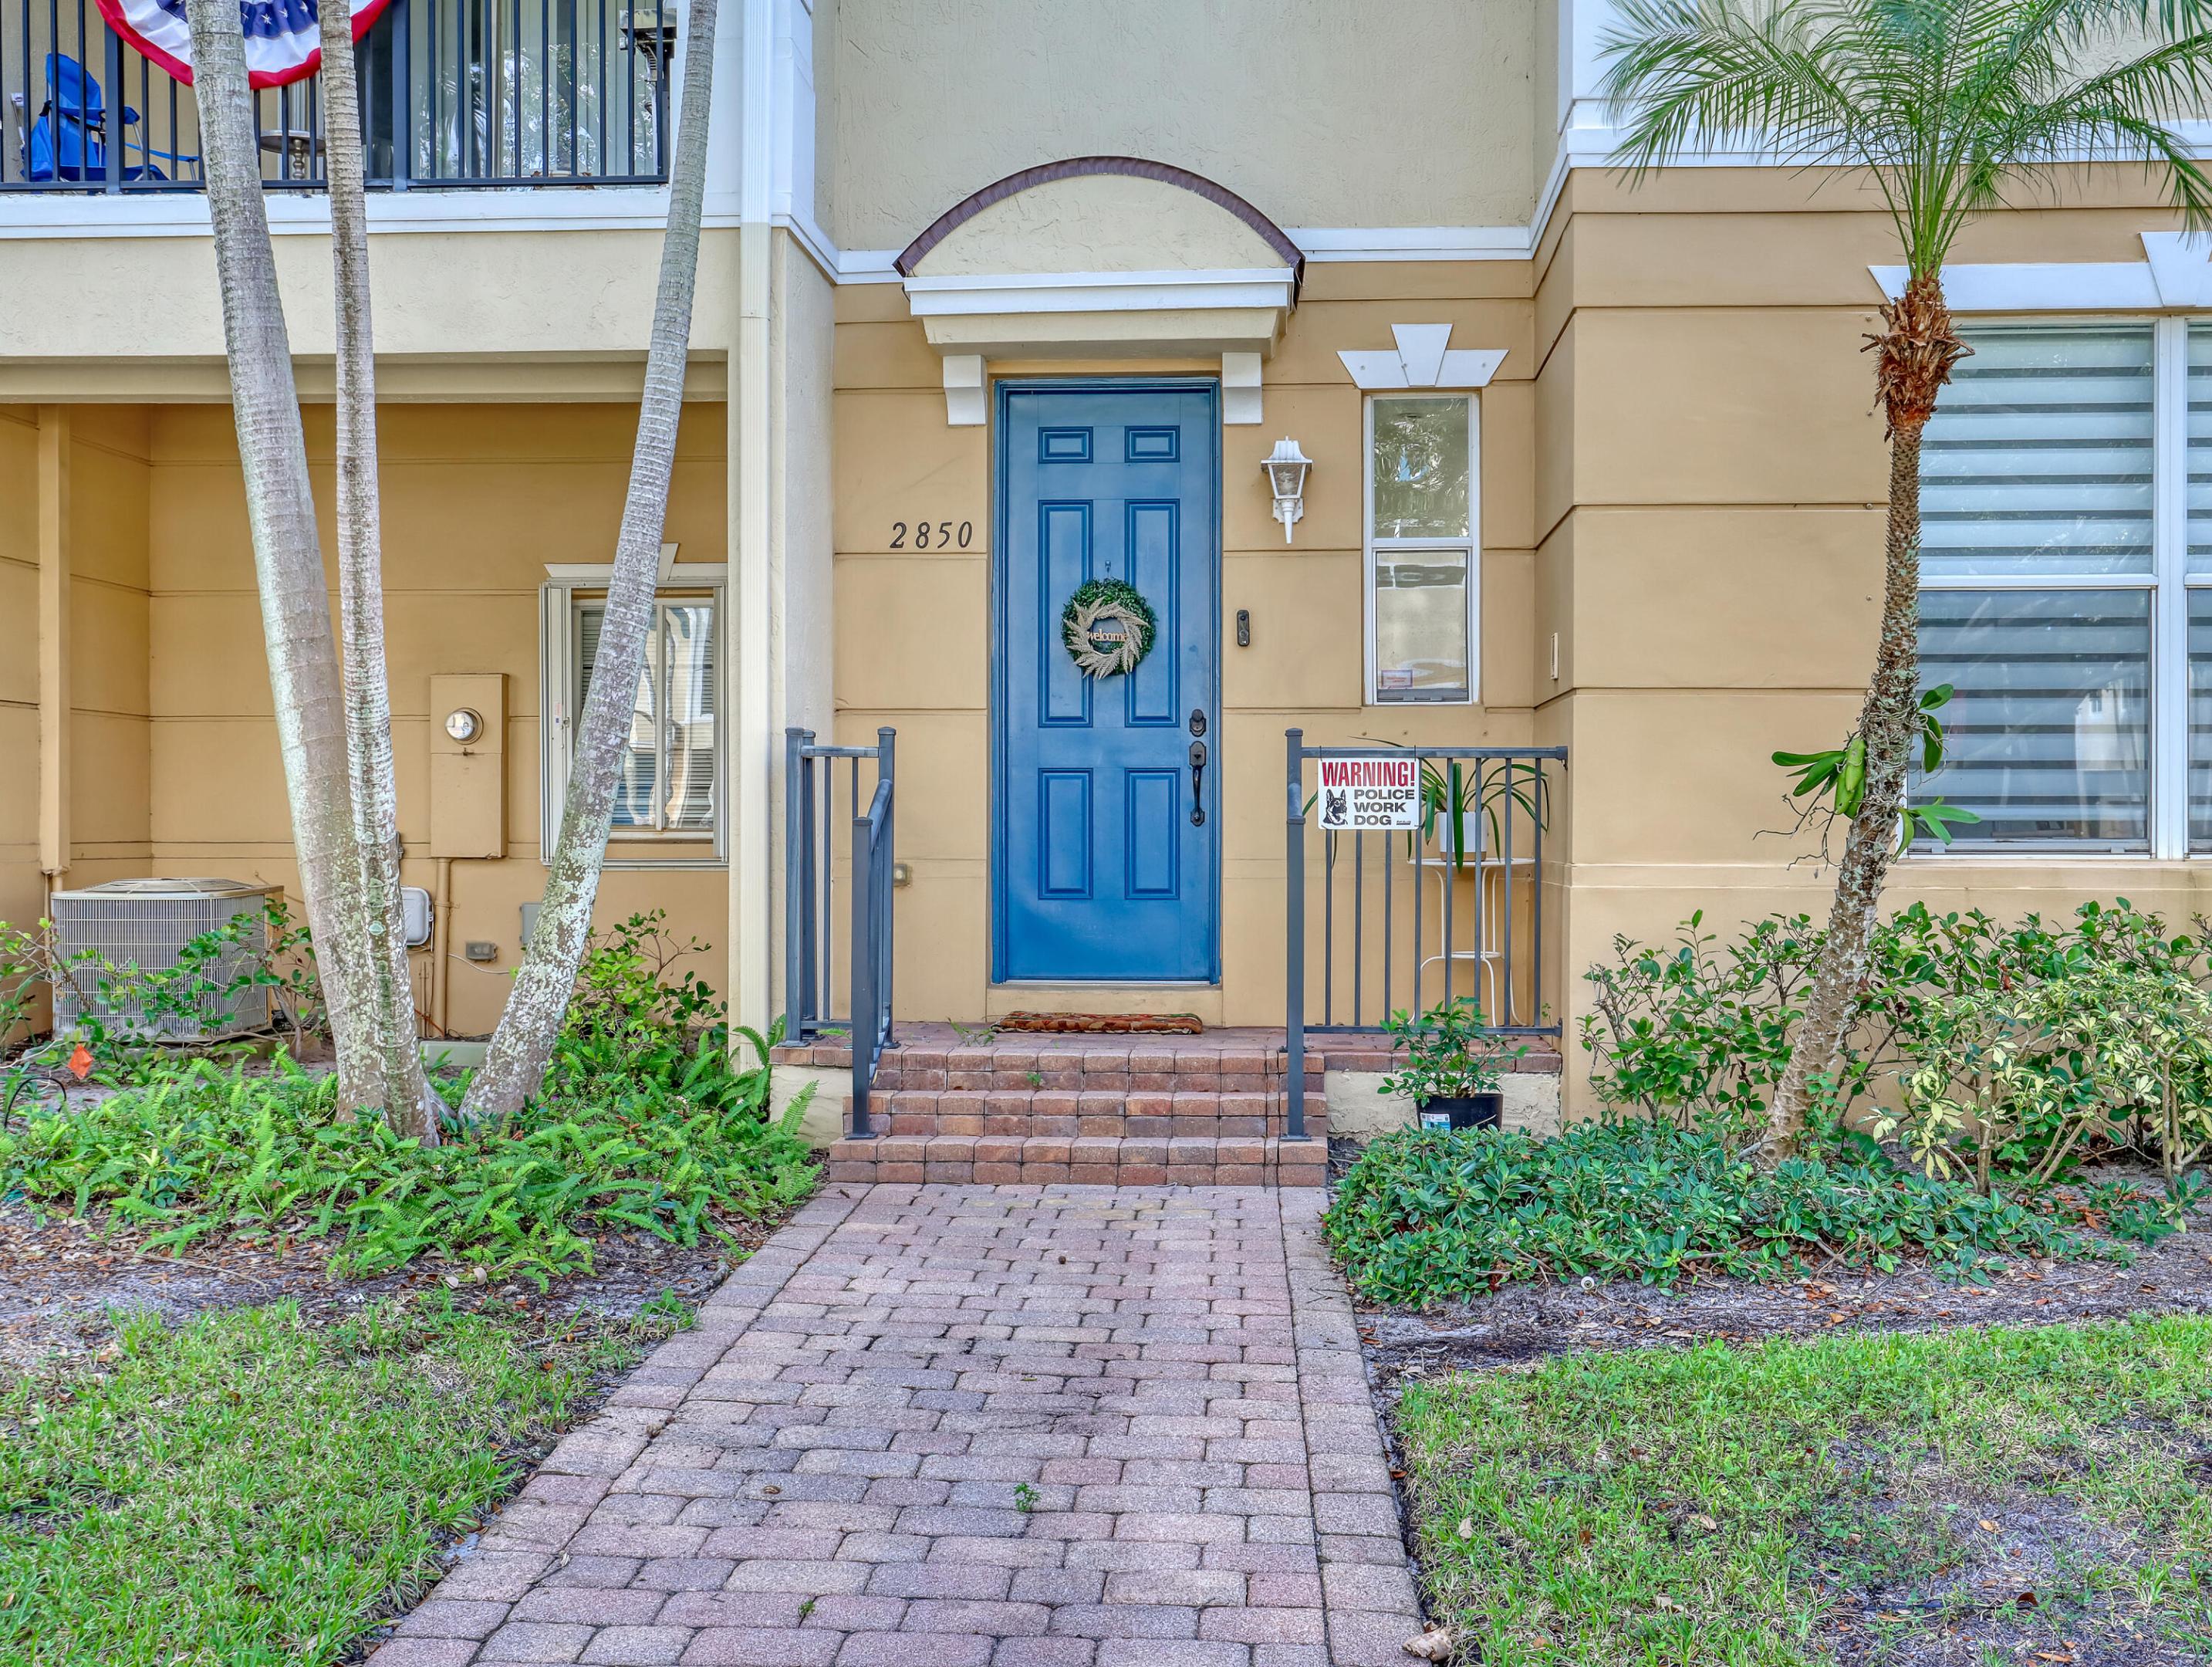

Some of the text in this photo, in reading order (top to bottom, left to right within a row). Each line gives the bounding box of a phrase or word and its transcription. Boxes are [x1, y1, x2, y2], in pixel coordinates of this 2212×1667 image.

[890, 521, 972, 549] 2850
[1086, 629, 1128, 641] welcome
[1322, 761, 1415, 786] WARNING!
[1354, 789, 1415, 800] POLICE
[1354, 802, 1407, 813] WORK
[1354, 815, 1392, 825] DOG
